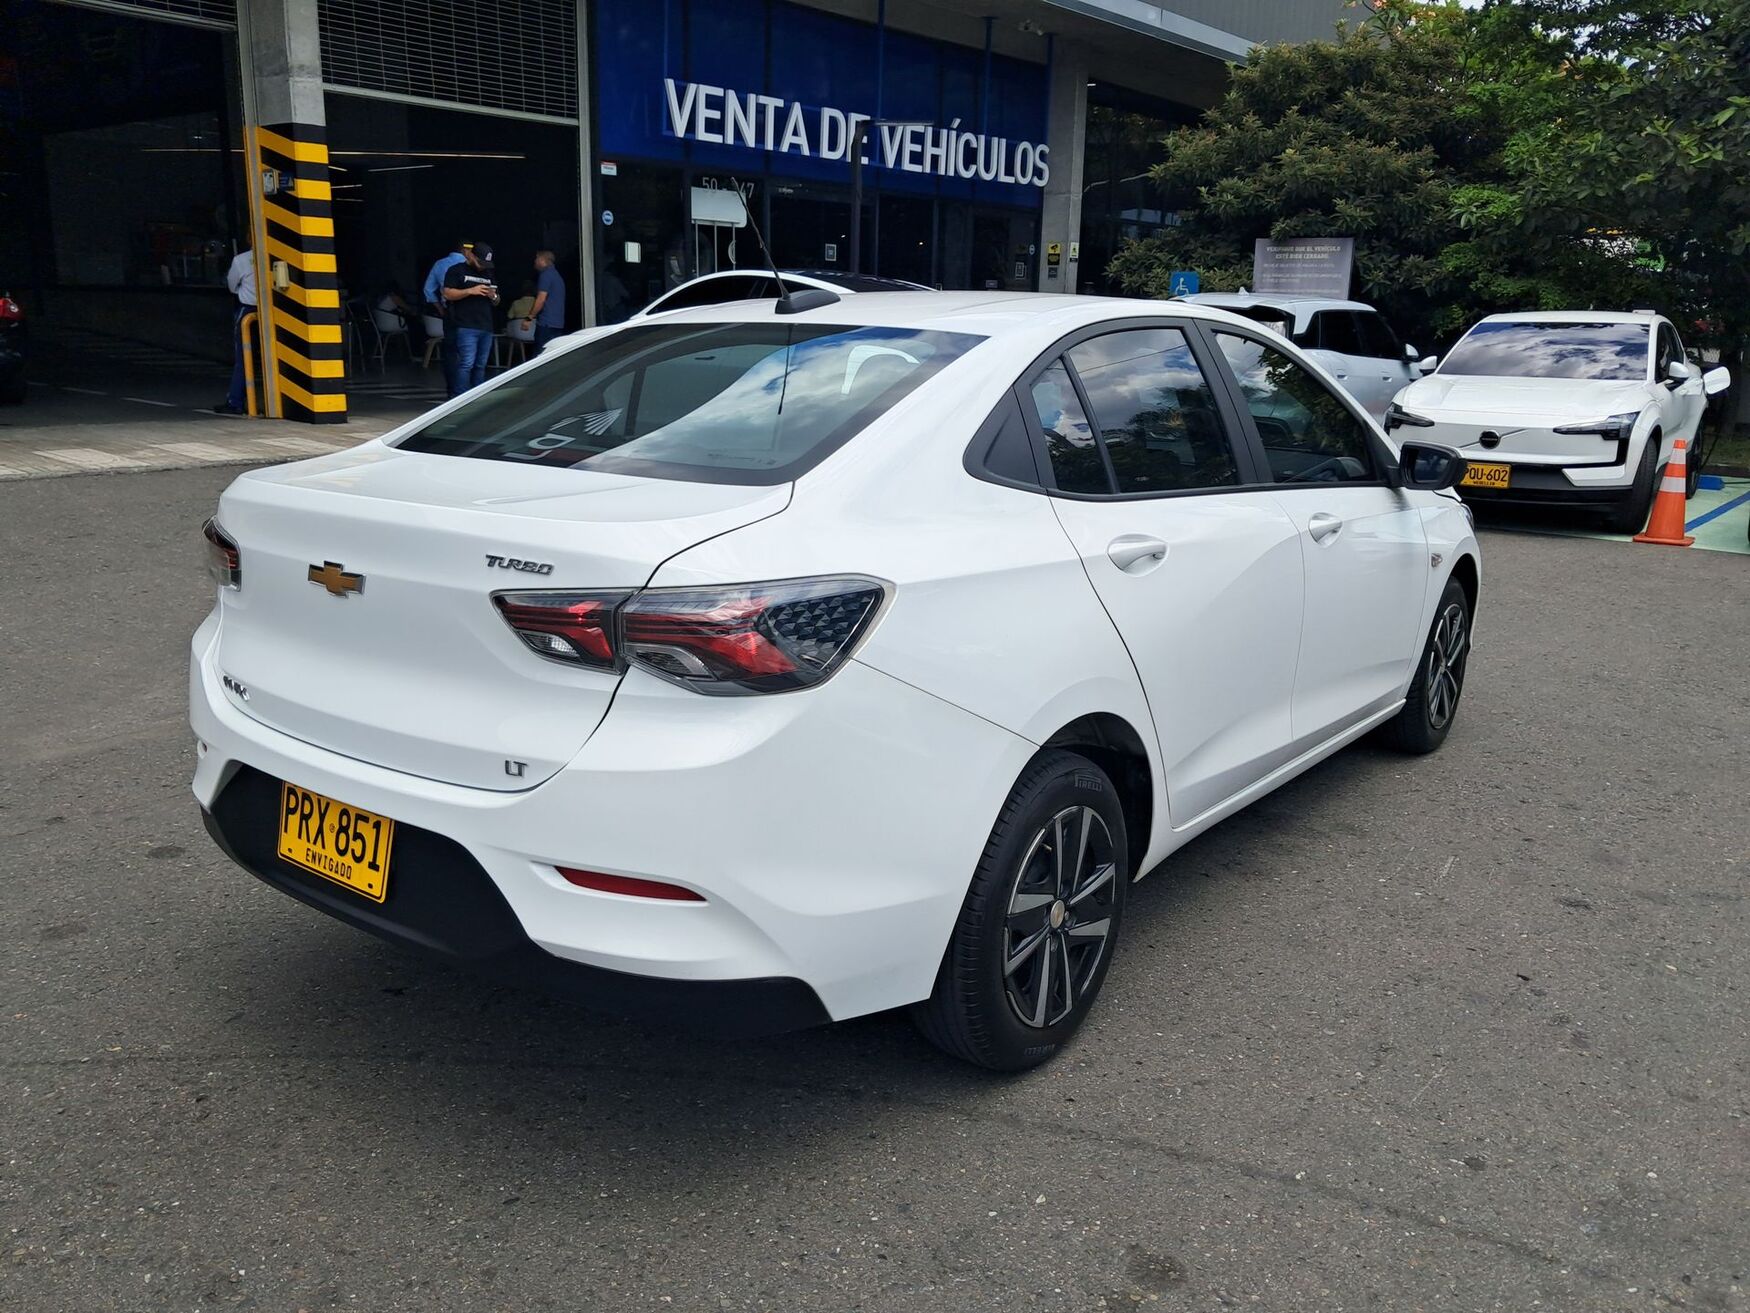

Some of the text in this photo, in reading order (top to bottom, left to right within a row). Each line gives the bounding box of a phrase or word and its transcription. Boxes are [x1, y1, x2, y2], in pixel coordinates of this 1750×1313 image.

[664, 78, 1050, 188] VENTA DE VEHÍCULOS
[485, 554, 554, 575] TURBO
[505, 760, 528, 777] LT
[305, 847, 352, 880] ENVIGADO
